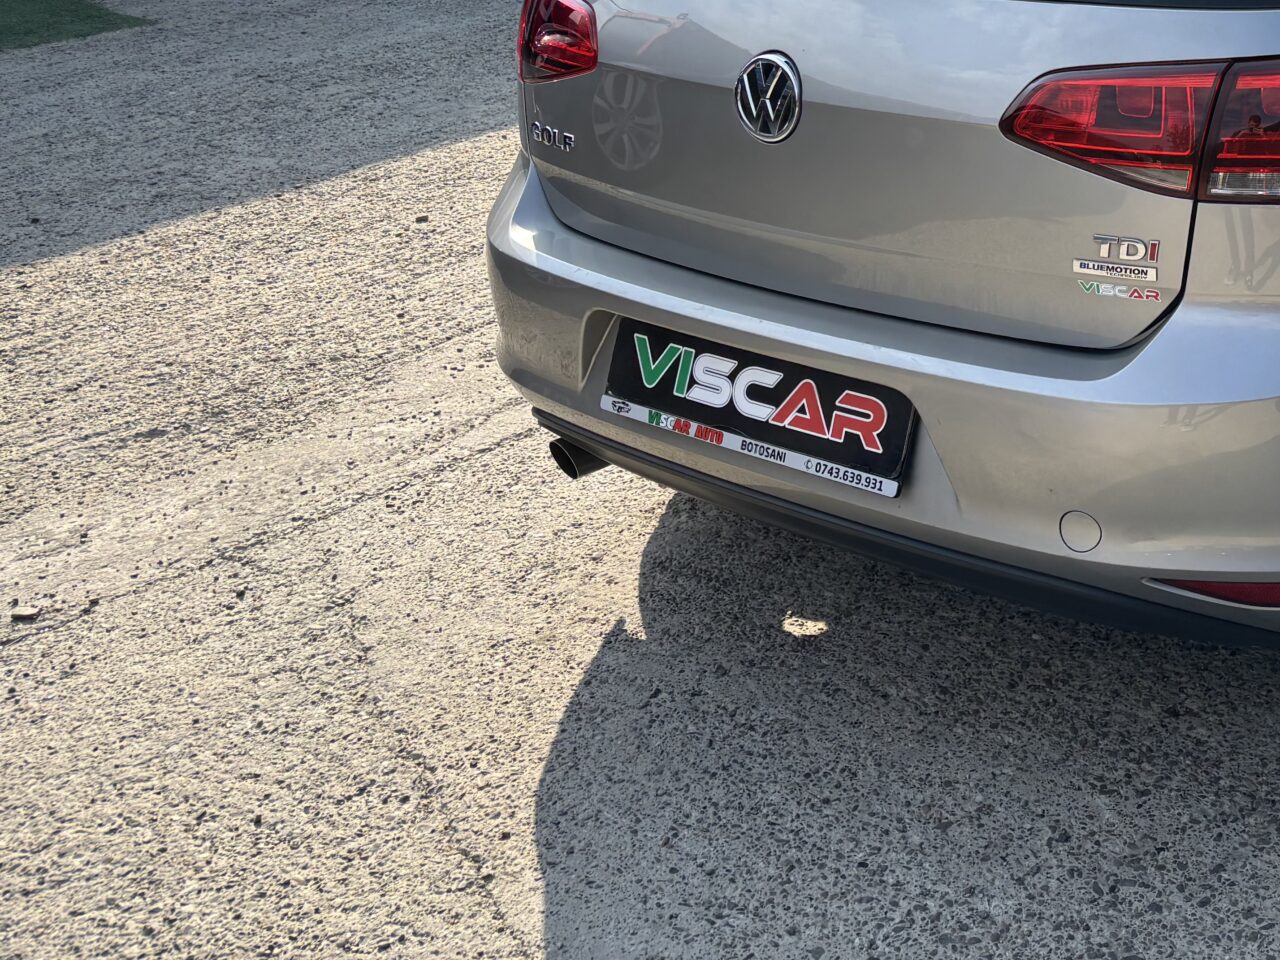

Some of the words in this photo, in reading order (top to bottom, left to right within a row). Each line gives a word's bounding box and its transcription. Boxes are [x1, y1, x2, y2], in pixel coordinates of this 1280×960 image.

[531, 121, 575, 152] GOLF
[1093, 233, 1160, 263] TDI
[1079, 262, 1148, 276] BLUEMOTION
[1078, 280, 1161, 302] VISCAR
[633, 333, 887, 454] VISCAR
[648, 409, 691, 435] VISCAR
[694, 424, 724, 445] AUTO
[740, 440, 787, 463] BOTOSANI
[815, 462, 884, 493] 0743.639.931
